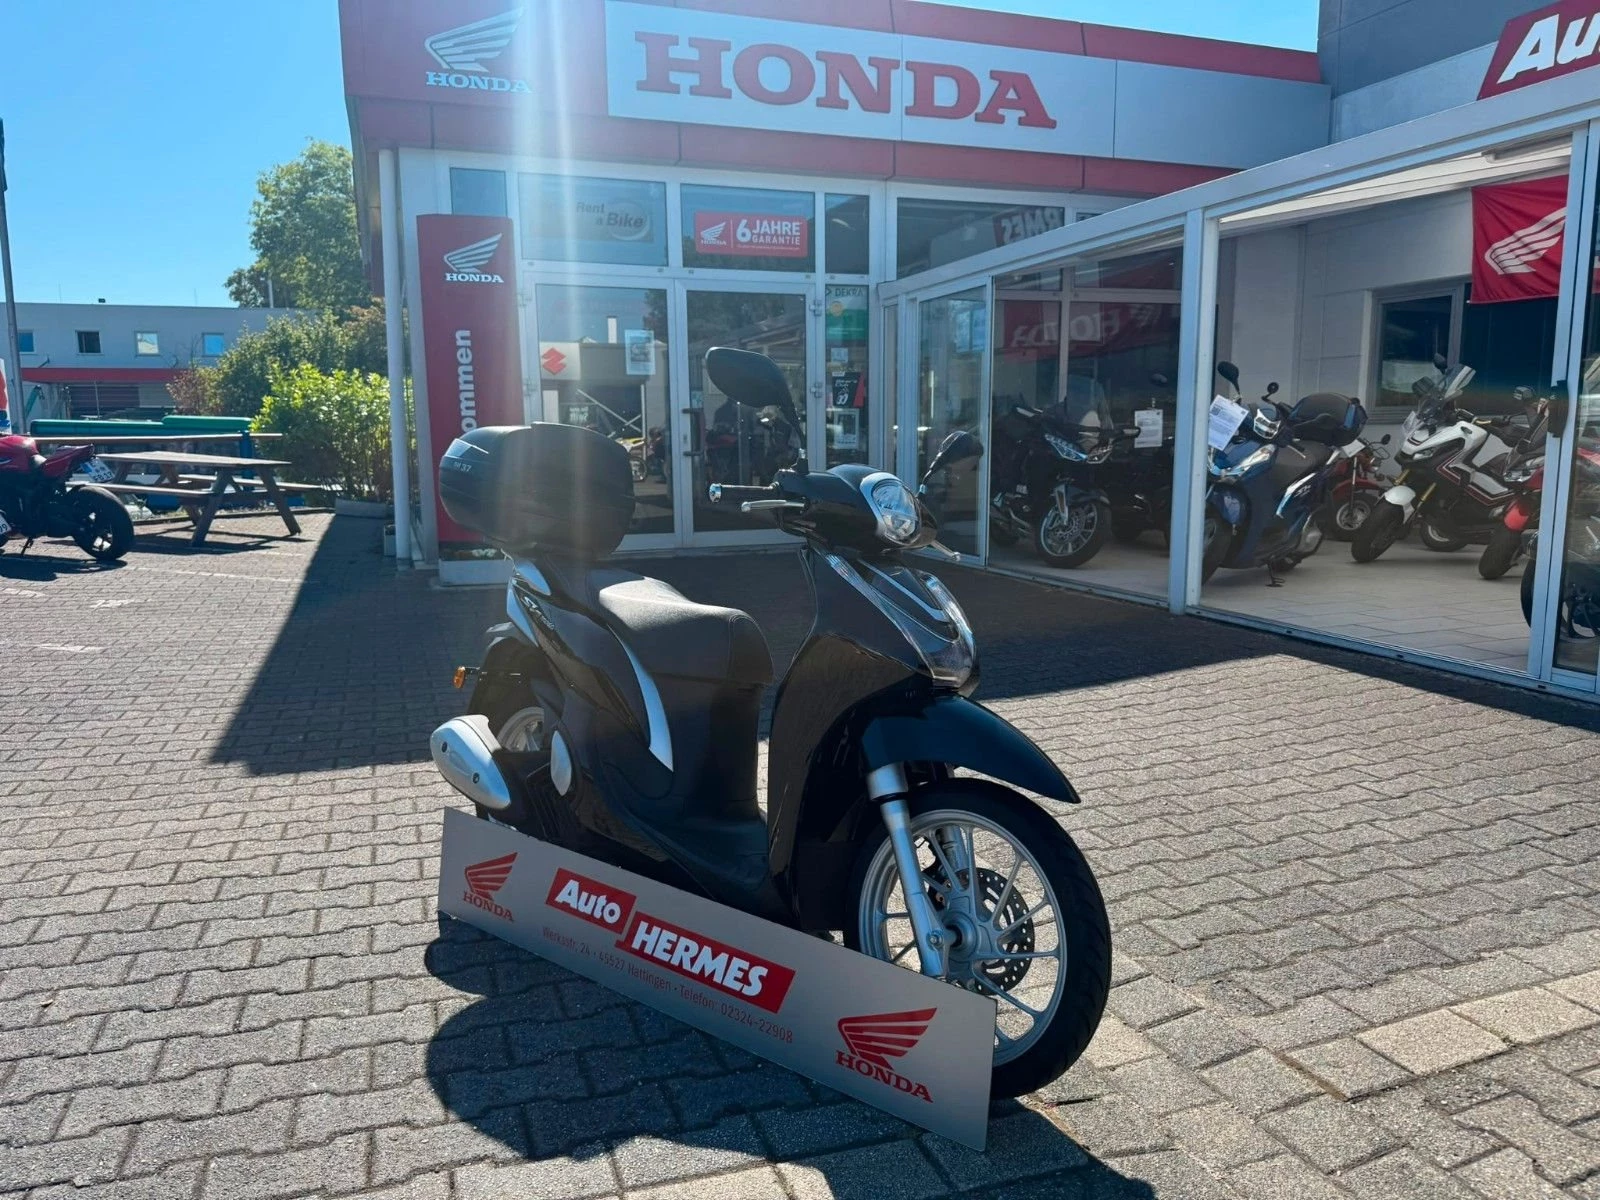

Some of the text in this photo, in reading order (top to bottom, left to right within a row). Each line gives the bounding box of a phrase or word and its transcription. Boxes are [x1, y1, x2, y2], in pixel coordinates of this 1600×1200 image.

[426, 71, 533, 94] HONDA
[634, 30, 1057, 129] HONDA
[607, 212, 644, 228] Bike
[736, 219, 801, 243] 6 JAHRE
[752, 235, 801, 245] GARANTIE
[445, 272, 504, 283] HONDA
[463, 891, 514, 922] HONDA
[555, 879, 621, 924] Auto
[631, 920, 769, 997] HERMES
[580, 942, 591, 957] 24
[628, 962, 671, 992] Hattingen
[721, 1002, 794, 1044] 02324-22908
[835, 1049, 934, 1104] HONDA
